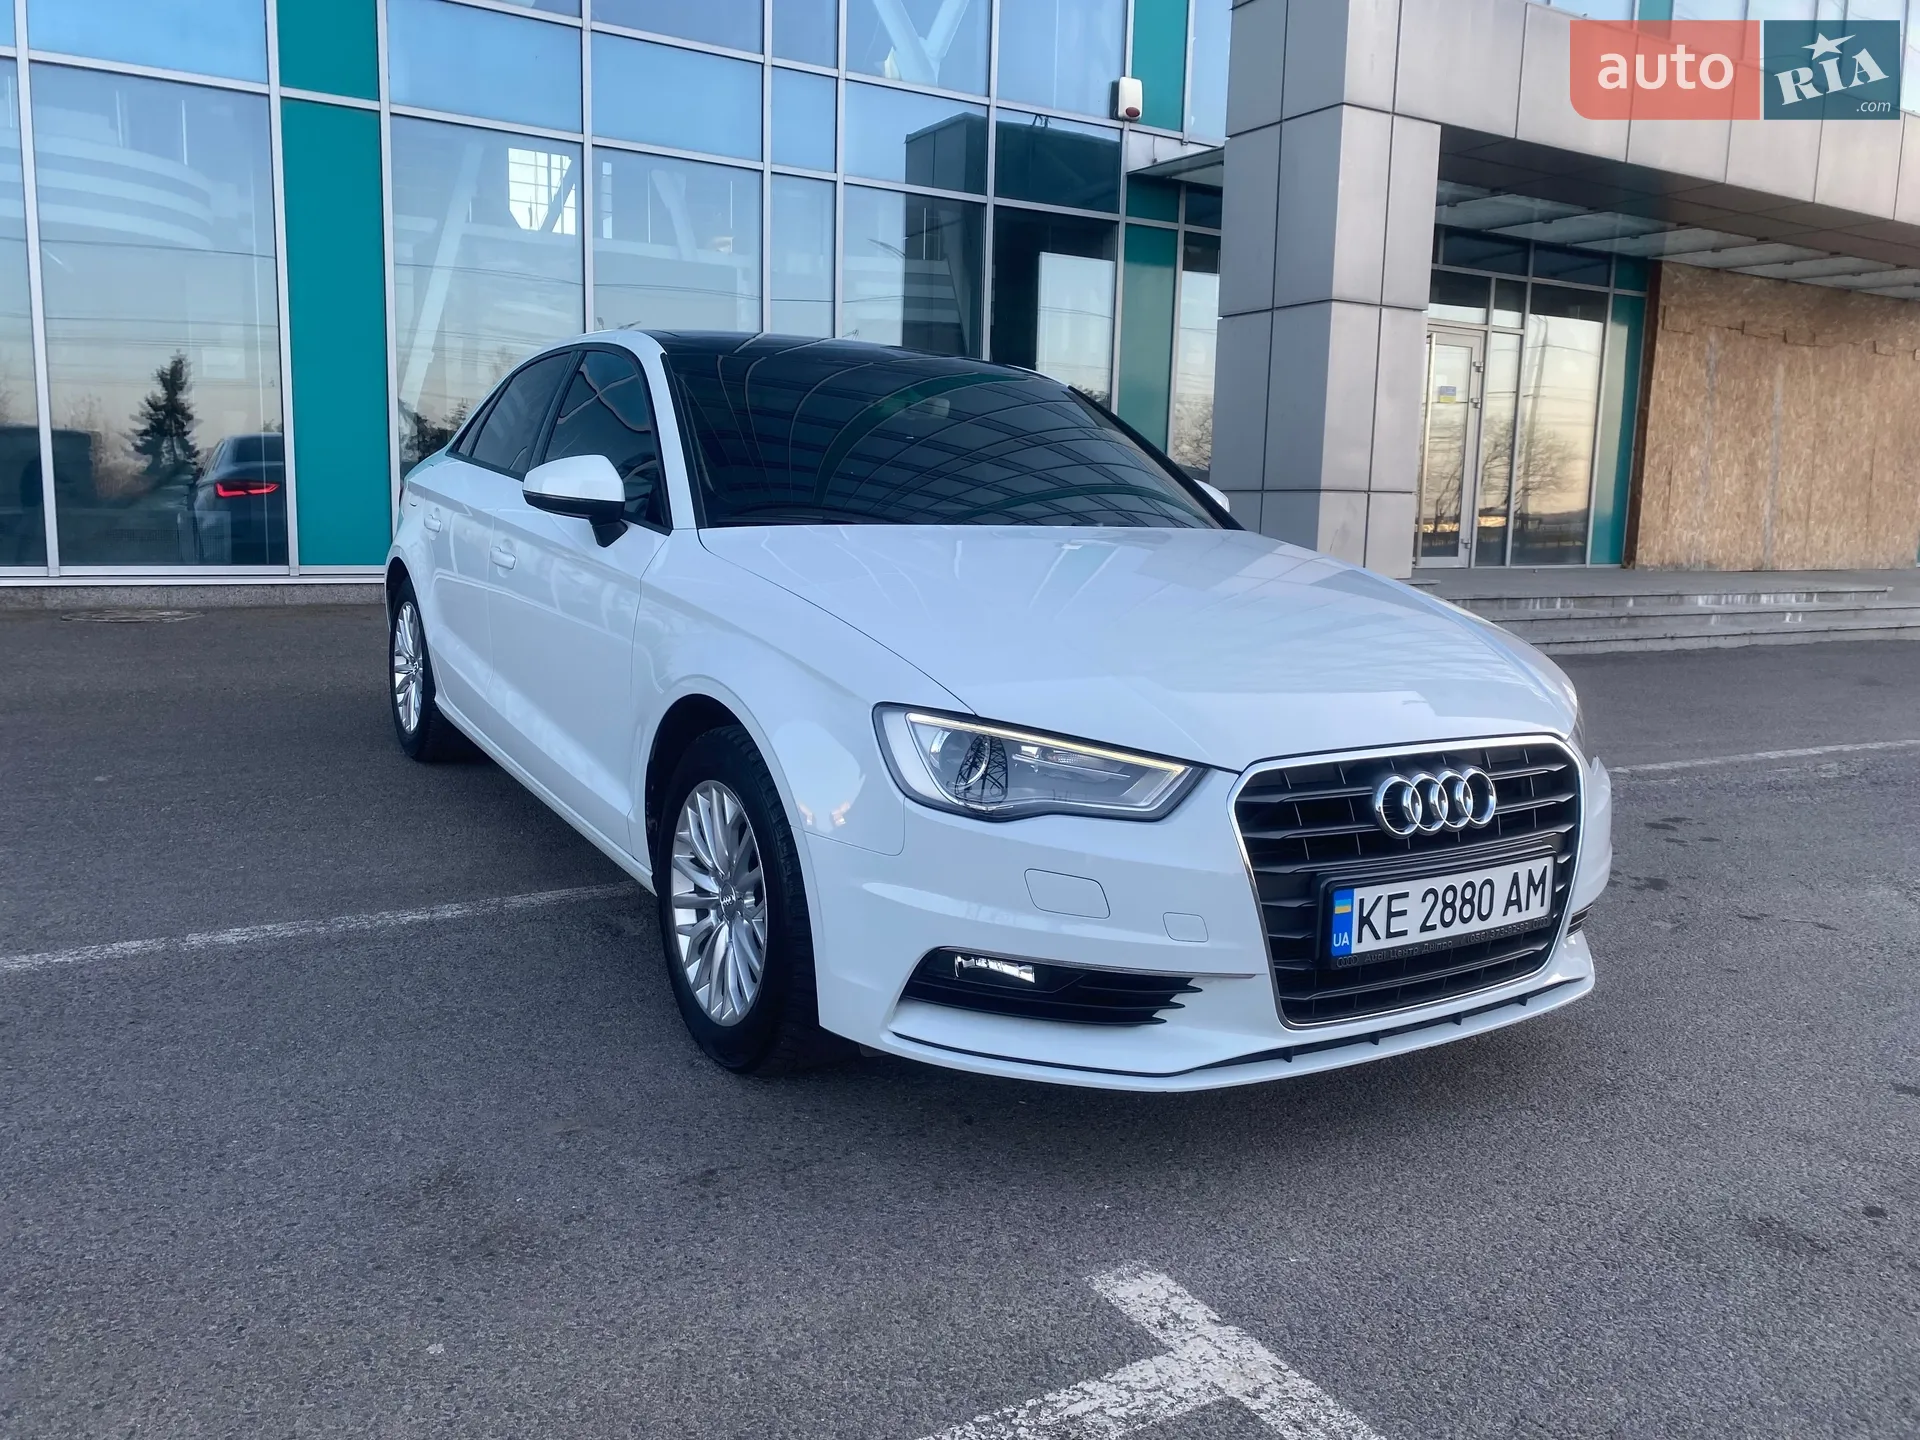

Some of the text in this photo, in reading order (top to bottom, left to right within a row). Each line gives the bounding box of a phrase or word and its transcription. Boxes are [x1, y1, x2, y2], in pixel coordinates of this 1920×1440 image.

[1357, 864, 1548, 944] KE 2880 AM
[1333, 932, 1350, 947] UA
[1364, 952, 1386, 963] Audi
[1390, 947, 1418, 959] Центр
[1421, 940, 1453, 954] Дніпро
